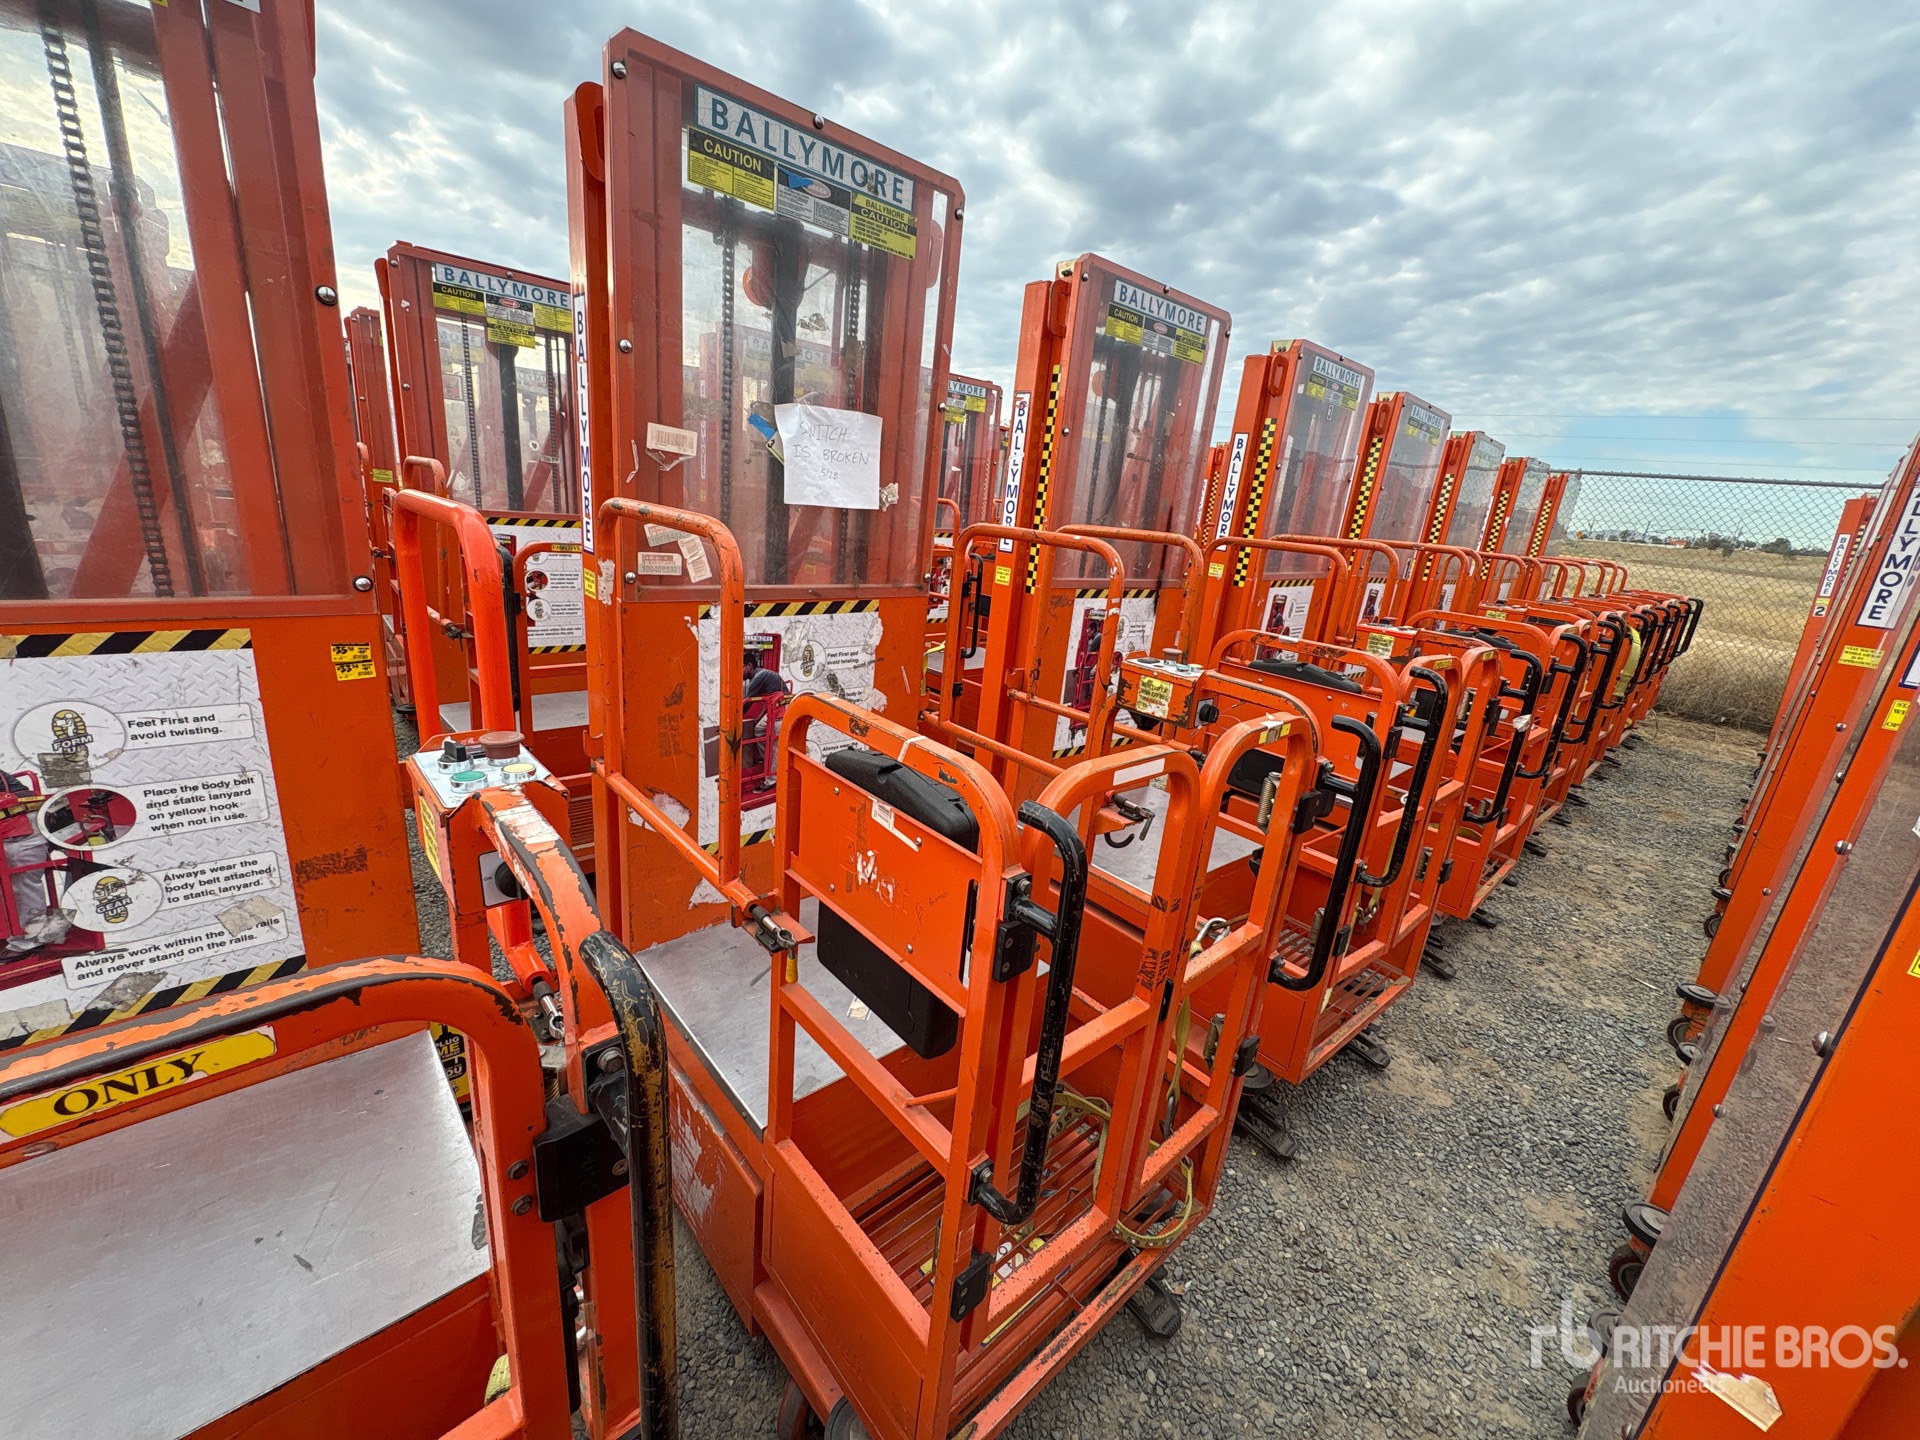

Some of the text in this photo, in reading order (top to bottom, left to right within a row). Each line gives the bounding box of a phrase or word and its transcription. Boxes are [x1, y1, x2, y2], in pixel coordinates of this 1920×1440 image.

[704, 139, 761, 172] CAUTION
[711, 97, 904, 204] BALLYMORE
[861, 208, 908, 232] CAUTION
[866, 199, 904, 220] BALLYMORE
[441, 286, 476, 299] CAUTION
[444, 267, 568, 307] BALLYMORE
[1120, 284, 1203, 331] BALLYMORE
[1315, 358, 1360, 387] BALLYMORE
[949, 382, 984, 396] LYMORE
[577, 311, 591, 542] BALLYMORE
[793, 444, 870, 465] IS BROKEN
[821, 468, 839, 480] 5/28
[1219, 439, 1243, 538] BALLYMOR
[1823, 537, 1847, 594] BALLYMORE
[1868, 493, 1920, 620] LLYMORE
[1815, 606, 1825, 616] 2
[128, 714, 216, 728] Feet First and
[53, 734, 93, 751] FORM
[130, 725, 222, 740] avoid twisting.
[143, 776, 255, 798] Place the body belt
[146, 788, 251, 810] and static lanyard
[149, 802, 239, 821] on yellow hook
[151, 811, 247, 832] when not in use.
[163, 859, 258, 882] Always wear the
[165, 866, 272, 893] body belt attached
[167, 879, 264, 904] to static lanyard.
[96, 898, 132, 914] GEAR
[108, 906, 126, 917] UP
[75, 917, 280, 970] Always work within the rails
[77, 933, 257, 981] and never stand on the rails.
[441, 1050, 460, 1058] TODAY
[446, 1065, 462, 1076] OU
[53, 1051, 206, 1116] ONLY
